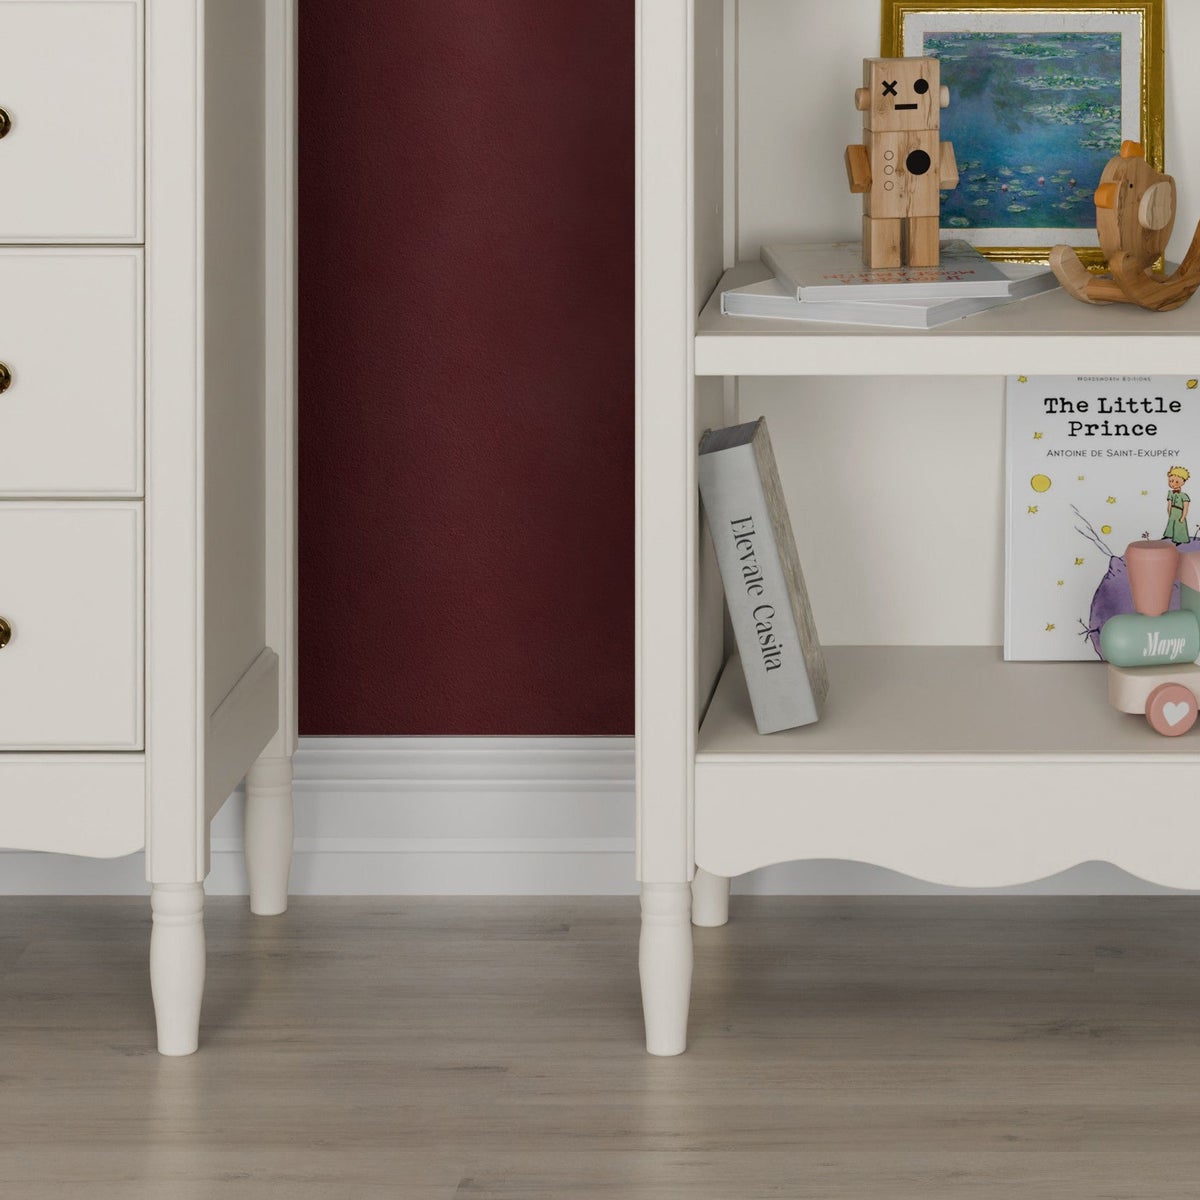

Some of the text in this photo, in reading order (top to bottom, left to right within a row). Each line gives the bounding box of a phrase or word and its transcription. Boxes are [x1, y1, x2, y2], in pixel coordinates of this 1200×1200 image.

[1044, 397, 1182, 414] The Little
[1068, 421, 1158, 436] Prince
[1046, 449, 1088, 458] ANTOINE
[1091, 450, 1104, 458] DE
[1142, 631, 1186, 661] Marye
